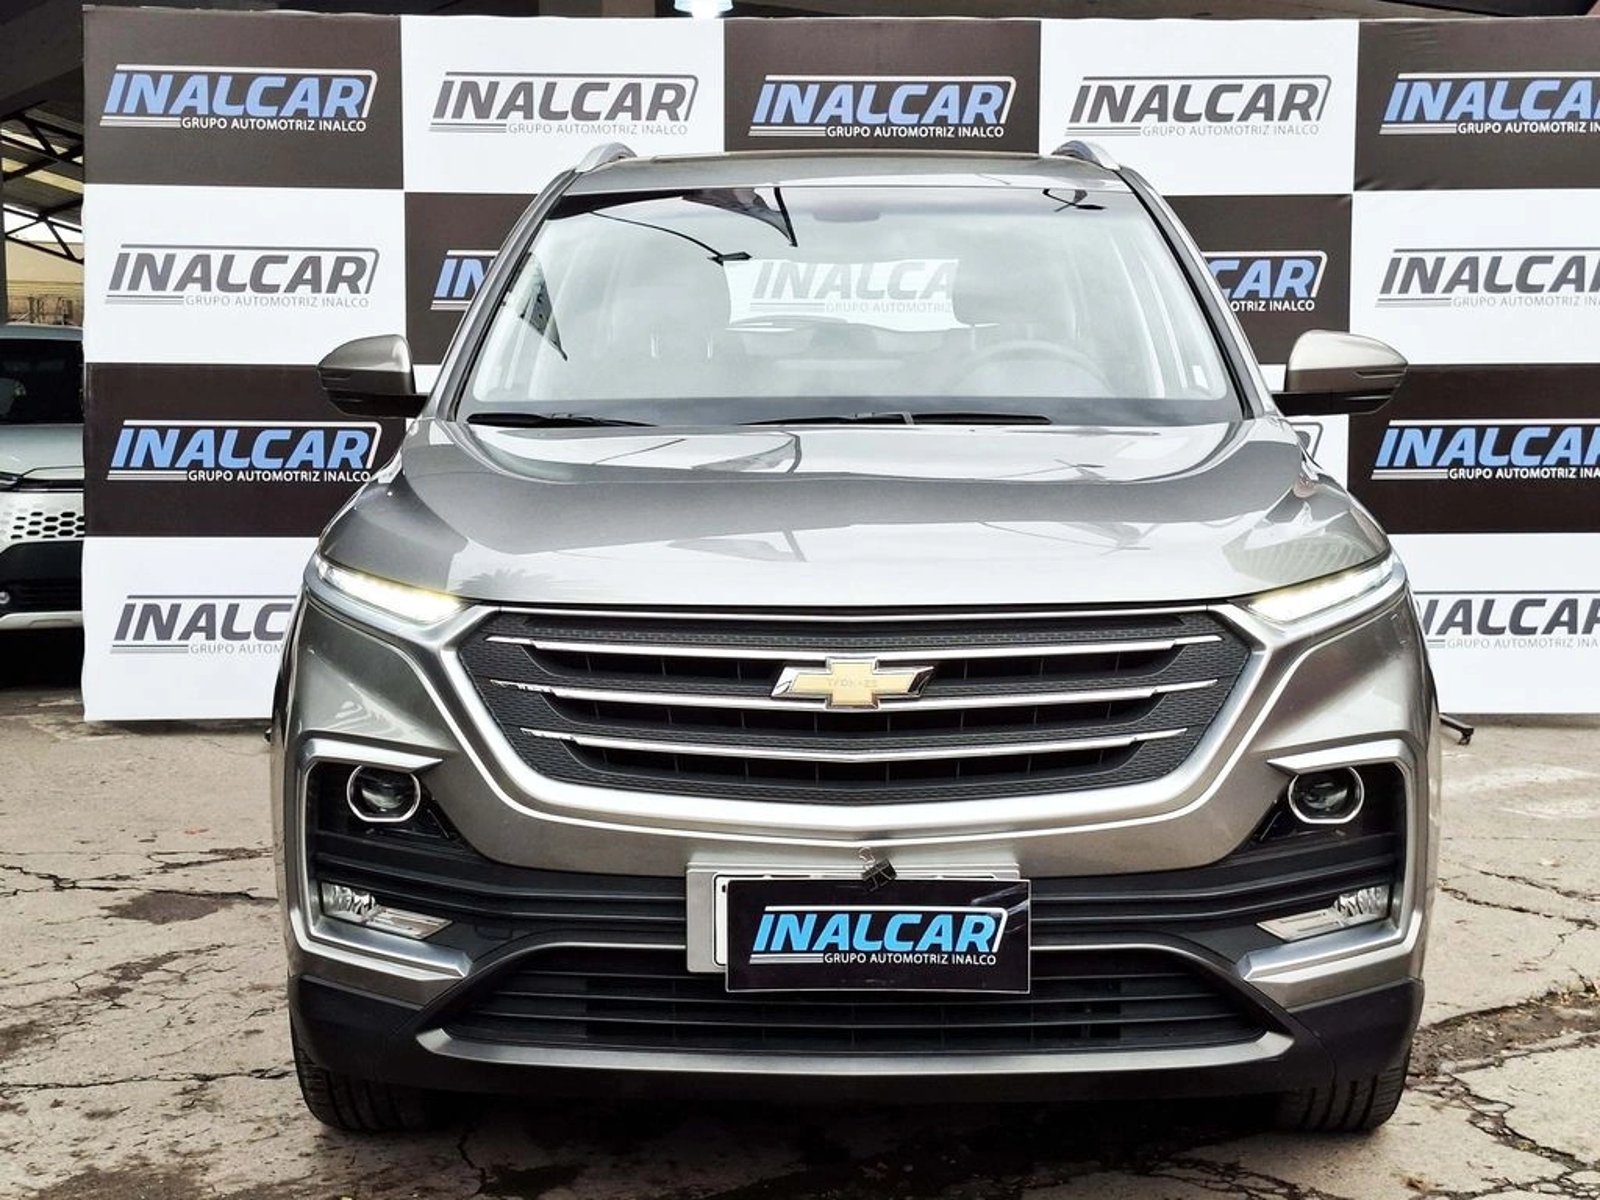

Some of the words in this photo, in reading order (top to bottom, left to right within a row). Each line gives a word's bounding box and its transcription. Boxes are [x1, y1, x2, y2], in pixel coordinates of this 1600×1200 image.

[103, 72, 366, 118] INALCAR
[433, 80, 688, 122] INALCAR
[1385, 79, 1600, 122] INALCA
[752, 83, 1004, 125] INALCAR
[1069, 83, 1320, 123] INALCAR
[181, 116, 228, 129] GRUPO
[231, 117, 315, 131] AUTOMOTRIZ
[318, 119, 367, 132] INALCO
[508, 123, 552, 135] GRUPO
[556, 123, 637, 135] AUTOMOTRIZ
[641, 124, 688, 136] INALCO
[1142, 125, 1185, 136] GRUPO
[1189, 125, 1270, 136] AUTOMOTRIZ
[1273, 124, 1319, 135] INALCO
[1458, 123, 1502, 134] GRUPO
[1504, 122, 1587, 133] AUTOMOTRIZ
[827, 126, 871, 138] GRUPO
[874, 126, 955, 138] AUTOMOTRIZ
[958, 126, 1004, 138] INALCO
[108, 252, 367, 294] INALCAR
[1379, 254, 1600, 294] INALCA
[185, 294, 231, 306] GRUPO
[235, 295, 318, 307] AUTOMOTRIZ
[321, 296, 369, 308] INALCO
[826, 301, 868, 313] GRUPO
[1269, 300, 1315, 312] INALCO
[1453, 296, 1497, 308] GRUPO
[1501, 296, 1580, 307] AUTOMOTRIZ
[111, 428, 370, 470] INALCAR
[188, 470, 233, 482] GRUPO
[237, 470, 320, 482] AUTOMOTRIZ
[323, 471, 370, 483] INALCO
[1449, 468, 1492, 480] GRUPO
[1495, 468, 1577, 479] AUTOMOTRIZ
[190, 643, 234, 654] GRUPO
[1447, 638, 1490, 649] GRUPO
[1494, 638, 1574, 649] AUTOMOTRIZ
[753, 912, 999, 953] INALCAR
[824, 953, 867, 964] GRUPO
[870, 953, 949, 965] AUTOMOTRIZ
[952, 953, 997, 966] INALCO
